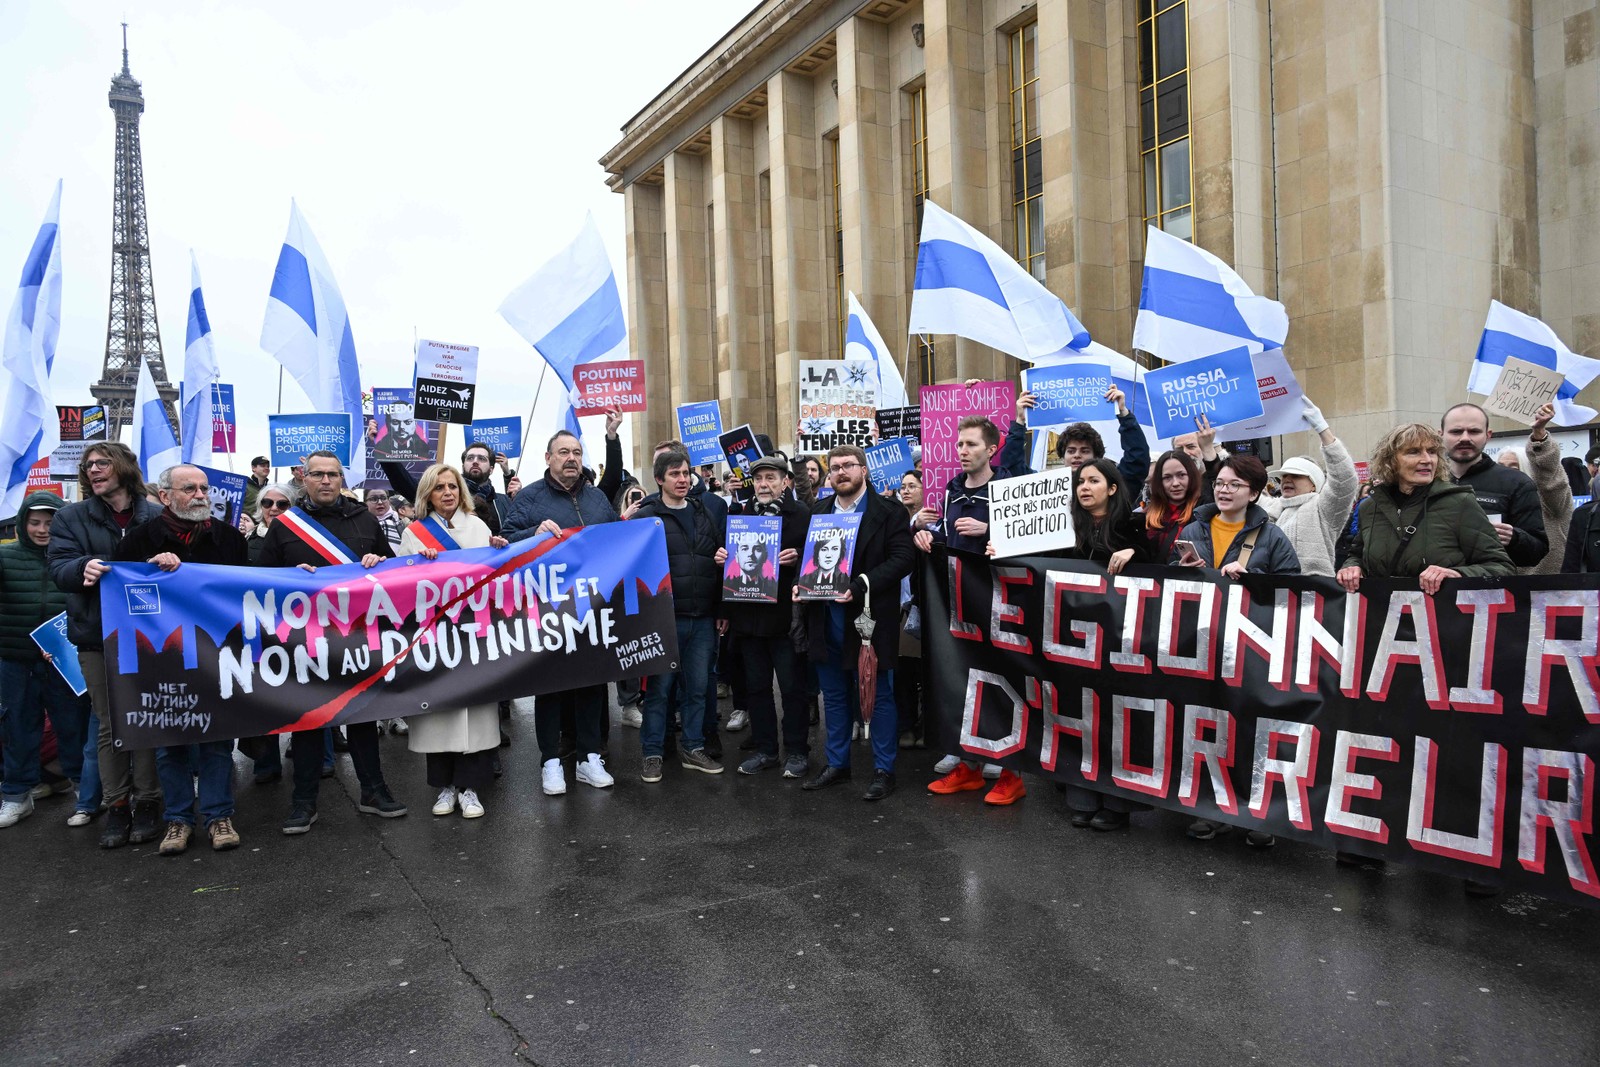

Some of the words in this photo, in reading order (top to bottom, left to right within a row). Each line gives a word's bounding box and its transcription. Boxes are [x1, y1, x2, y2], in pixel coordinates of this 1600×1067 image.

[450, 344, 470, 352] REGIME
[435, 363, 462, 371] GENOCIDE
[579, 367, 637, 381] POUTINE
[586, 383, 610, 394] EST
[613, 381, 632, 392] UN
[1032, 378, 1074, 391] RUSSIE
[1077, 377, 1108, 387] SANS
[1161, 368, 1226, 394] RUSSIA
[1257, 377, 1275, 387] ТИНА
[420, 384, 448, 394] AIDEZ
[802, 384, 874, 404] LUMIÈRE
[1033, 387, 1107, 400] PRISONNIERS
[1164, 377, 1239, 407] WITHOUT
[419, 397, 468, 409] L'UKRAINE
[579, 394, 642, 409] ASSASSIN
[922, 390, 947, 412] NOUS
[964, 386, 1009, 411] SOMMES
[1033, 397, 1098, 411] POLITIQUES
[213, 404, 231, 412] OTRE
[378, 404, 414, 414] FREEDO
[1168, 399, 1216, 421] PUTIN
[683, 414, 709, 426] SOUTIEN
[710, 412, 715, 421] À
[214, 422, 233, 432] ÔTE
[275, 426, 315, 436] RUSSIE
[318, 426, 346, 435] SANS
[472, 426, 509, 436] RUSSIE
[685, 422, 716, 436] L'UKRAINE
[837, 420, 870, 434] LES
[923, 416, 952, 439] PAS
[276, 435, 345, 444] PRISONNIERS
[473, 436, 500, 444] SANS
[727, 438, 748, 454] STOP
[800, 430, 874, 451] TÉNÈBRES
[276, 443, 337, 454] POLITIQUES
[489, 442, 514, 452] UTINE
[865, 443, 903, 470] ОССИЯ
[30, 468, 50, 476] UTINE
[870, 470, 885, 482] ЕЗ
[28, 478, 52, 486] TATEU
[872, 473, 906, 490] УТИН
[209, 485, 243, 504] DOM!
[991, 484, 1010, 503] La
[994, 503, 1021, 521] n'est
[1041, 494, 1068, 511] notre
[1005, 512, 1067, 539] tradition
[729, 532, 778, 546] FREEDOM!
[809, 527, 856, 542] FREEDOM!
[242, 588, 351, 640] NON
[365, 574, 403, 625] À
[416, 563, 570, 623] POUTINE
[576, 577, 598, 598] ET
[615, 640, 639, 658] МИР
[640, 632, 661, 648] БЕЗ
[948, 556, 1600, 722] LEGIONNAIR
[218, 636, 330, 700] NON
[341, 644, 370, 675] AU
[381, 608, 618, 682] POUTINISME
[619, 644, 665, 670] ПУТИНА!
[158, 682, 187, 695] НЕТ
[141, 690, 199, 710] ПУТИНУ
[126, 709, 211, 733] ПУТИНИЗМУ
[960, 667, 1599, 897] D'HORREUR
